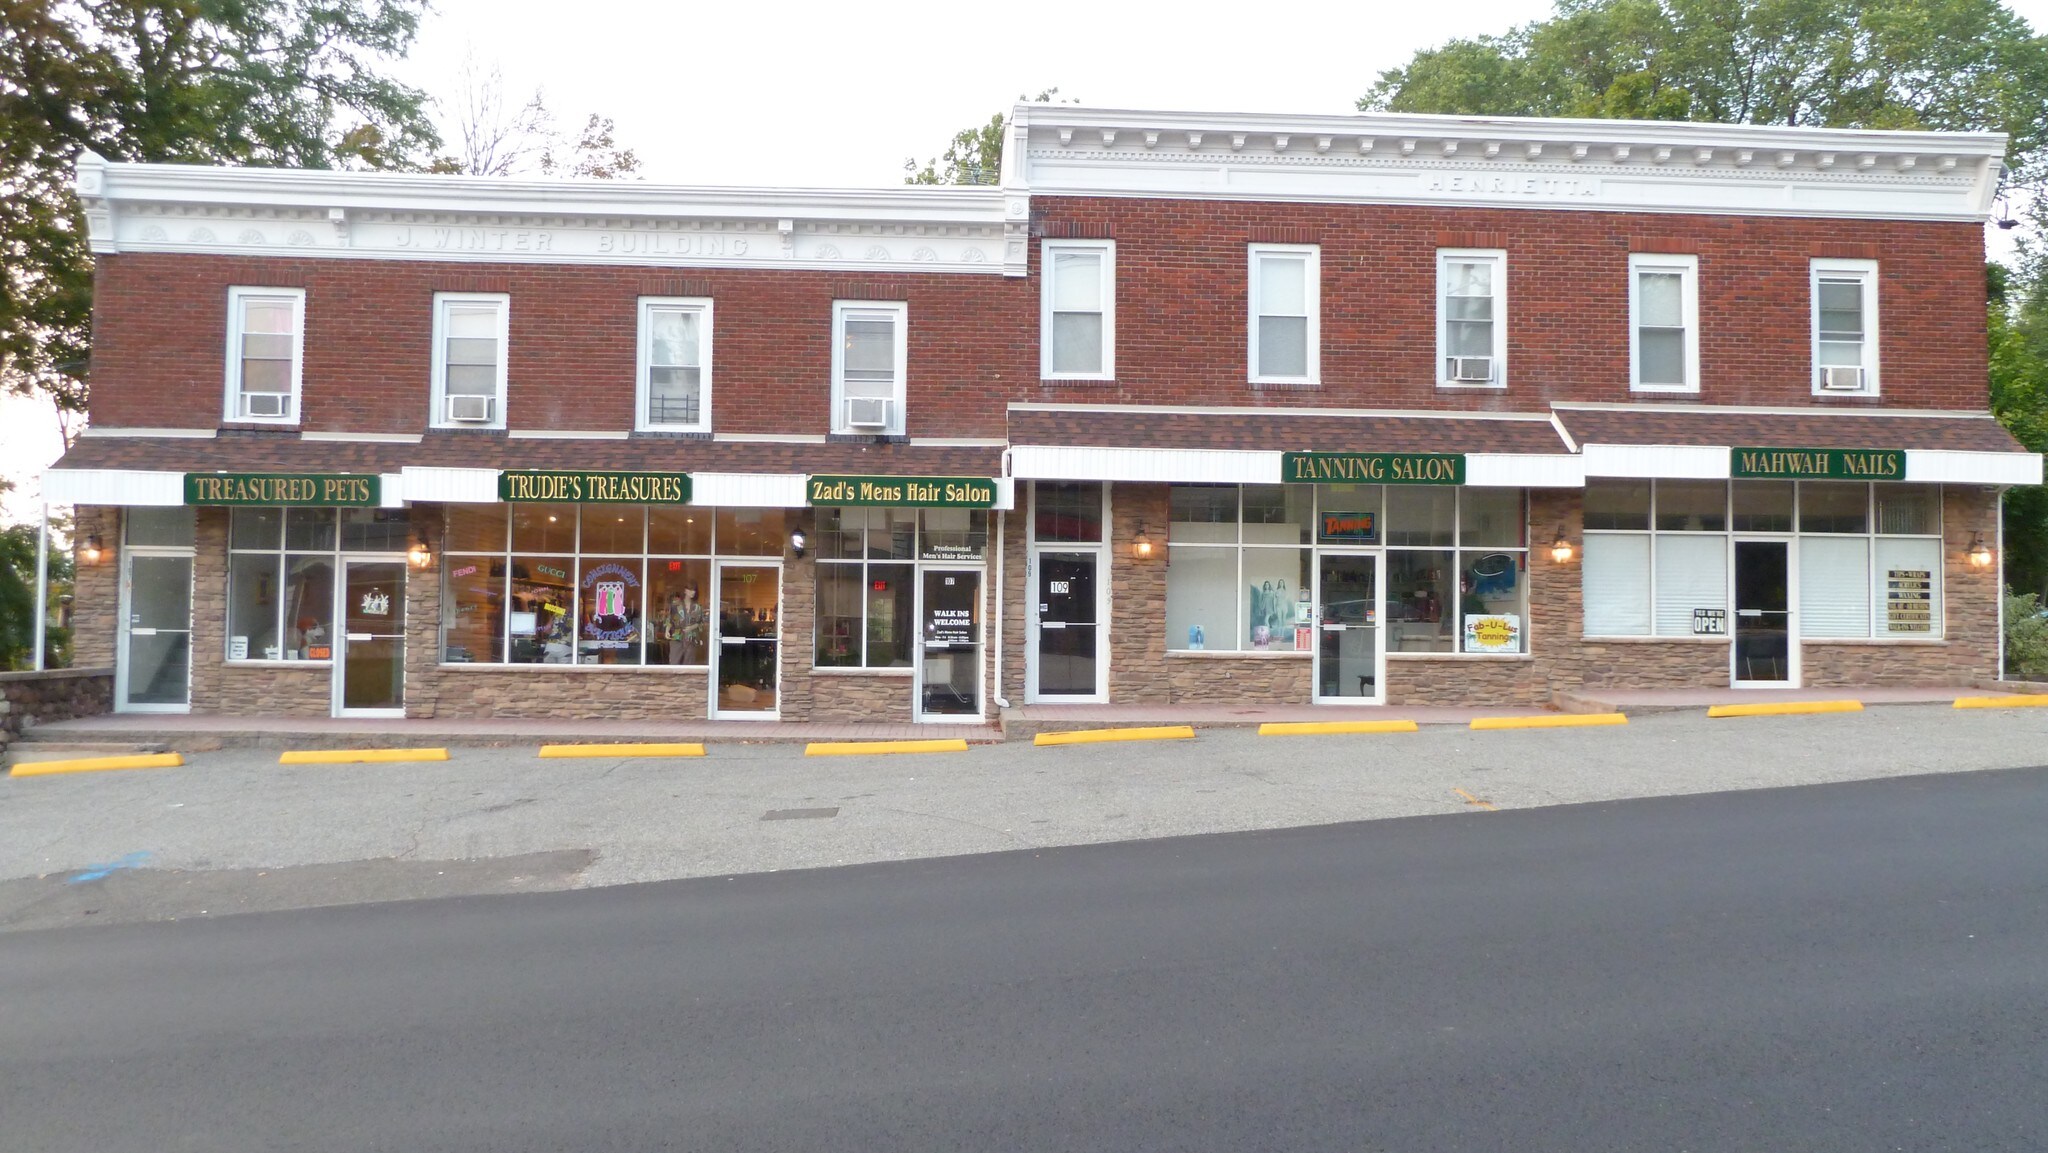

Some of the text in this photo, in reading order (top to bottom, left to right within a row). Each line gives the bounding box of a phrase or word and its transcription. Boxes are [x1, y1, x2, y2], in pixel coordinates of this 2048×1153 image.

[1428, 173, 1596, 196] HENRIETTA
[396, 228, 750, 256] J. WINTER BUILDING
[1293, 457, 1456, 481] TANNING SALON
[1741, 452, 1897, 476] MAHWAH NAILS
[195, 478, 370, 502] TREASURED PETS
[507, 474, 681, 501] TRUDIE'S TREASURES
[813, 481, 991, 502] Zad's Mens Hair Salon
[452, 565, 477, 578] FENDI
[537, 565, 566, 579] GUCCI
[669, 561, 681, 571] EXIT
[583, 563, 640, 588] CONSIGNMENT
[743, 574, 758, 583] 107
[874, 581, 886, 590] EXIT
[1052, 582, 1068, 593] 109
[934, 618, 970, 626] WELCOME
[1467, 621, 1518, 633] Fab-U-Lus
[1695, 616, 1724, 632] OPEN
[1478, 632, 1509, 642] Tanning
[310, 647, 330, 658] CLOSED
